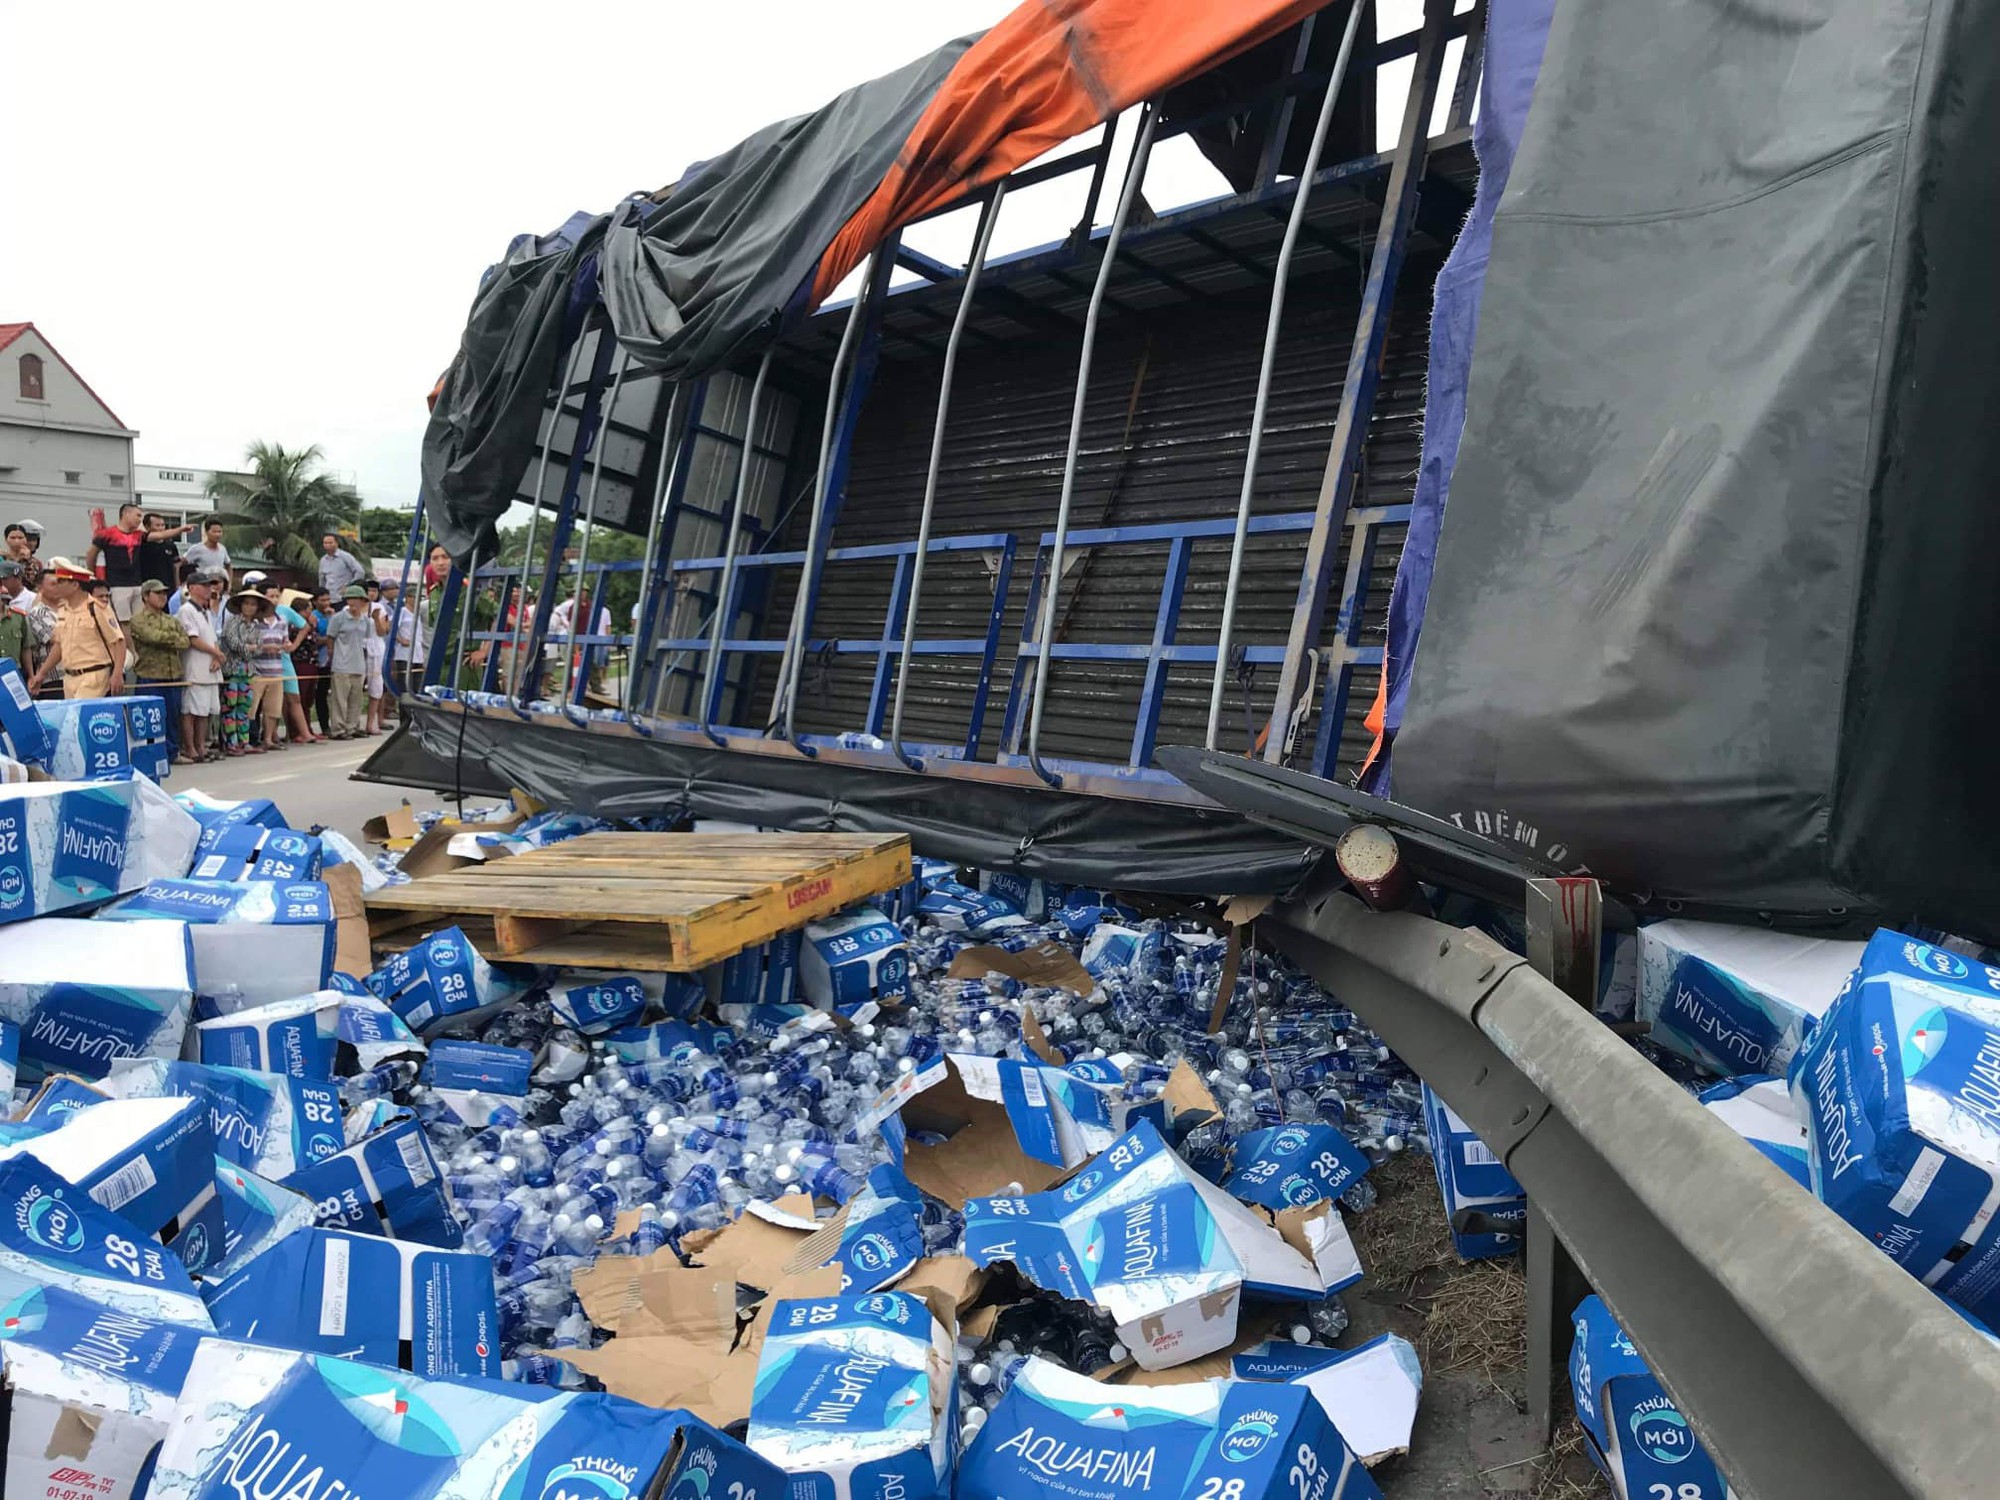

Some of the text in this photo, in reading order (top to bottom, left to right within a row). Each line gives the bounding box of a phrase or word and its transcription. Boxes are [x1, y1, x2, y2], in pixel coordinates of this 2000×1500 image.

[148, 708, 161, 723] 28
[94, 752, 120, 768] 28
[63, 822, 127, 870] AQUAFINA
[273, 861, 295, 879] 28
[139, 884, 231, 909] AQUAFINA
[1048, 897, 1062, 908] 28
[287, 904, 319, 914] 28
[838, 936, 859, 952] 28
[391, 957, 409, 977] 28
[393, 971, 411, 987] CHAI
[440, 974, 465, 992] 28
[445, 991, 468, 1003] CHAI
[32, 1011, 146, 1061] AQUAFINA
[1674, 982, 1771, 1070] AQUAFINA
[285, 1026, 304, 1078] AQUAFINA
[303, 1088, 331, 1102] CHAI
[304, 1101, 335, 1124] 28
[1128, 1135, 1145, 1155] CHAI
[1109, 1145, 1132, 1172] 28
[1249, 1160, 1280, 1176] 28
[1310, 1151, 1340, 1179] 28
[1241, 1173, 1268, 1185] CHAI
[1328, 1166, 1352, 1188] CHAI
[14, 1184, 43, 1232] THÙNG
[316, 1197, 350, 1228] 28
[341, 1188, 365, 1222] CHAI
[989, 1199, 1016, 1215] 28
[874, 1233, 899, 1259] THÙNG
[1121, 1195, 1159, 1281] AQUAFINA
[104, 1233, 142, 1278] 28
[144, 1248, 166, 1281] CHAI
[858, 1245, 881, 1266] MỚI
[425, 1279, 435, 1328] AQUAFINA
[809, 1303, 839, 1324] 28
[477, 1312, 489, 1343] pepsi
[788, 1307, 807, 1327] CHAI
[61, 1312, 165, 1381] AQUAFINA
[426, 1328, 436, 1352] CHAI
[796, 1351, 892, 1425] AQUAFINA
[1237, 1408, 1279, 1426] THÙNG
[1228, 1434, 1263, 1448] MỚI
[1644, 1428, 1685, 1445] MỚI
[571, 1456, 639, 1484] THÙNG
[688, 1445, 719, 1478] THÙNG
[995, 1426, 1157, 1492] AQUAFINA
[1289, 1443, 1319, 1500] 28
[1050, 1480, 1066, 1491] của
[1195, 1477, 1246, 1500] 28
